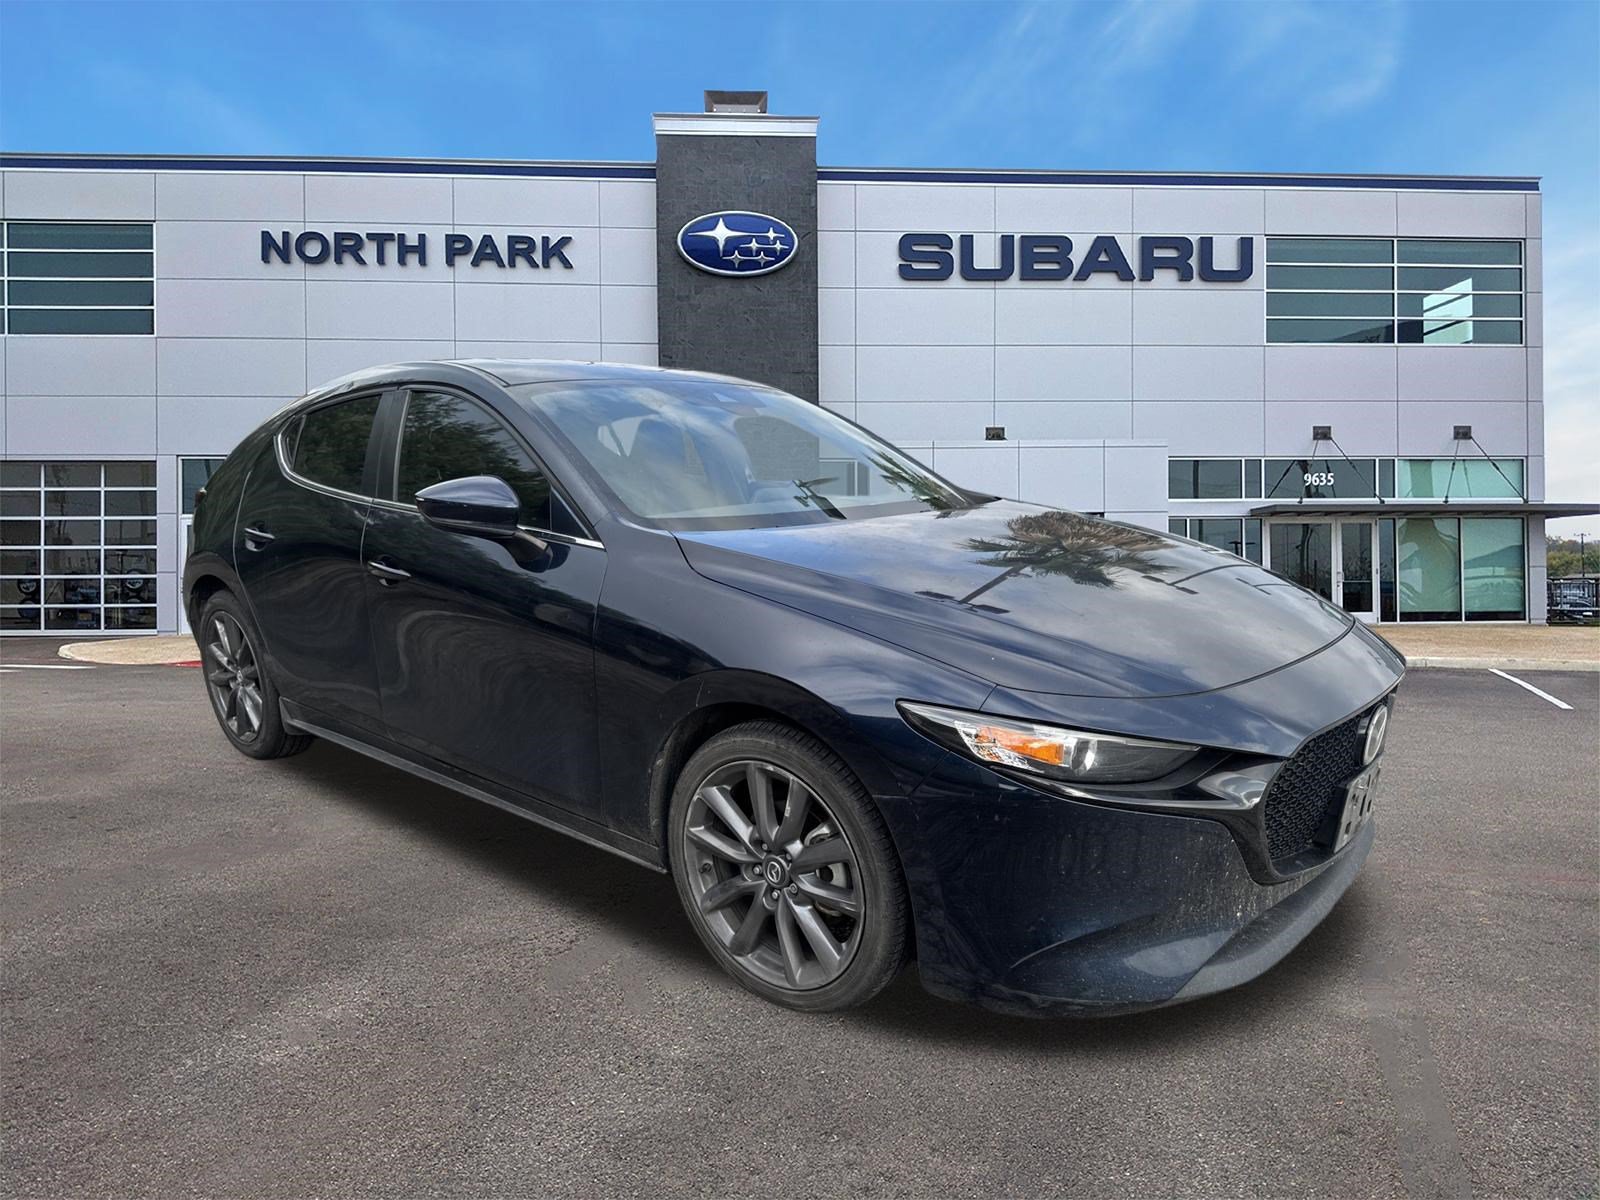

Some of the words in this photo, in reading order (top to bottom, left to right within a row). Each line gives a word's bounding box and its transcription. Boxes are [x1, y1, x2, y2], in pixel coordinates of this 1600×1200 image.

[260, 230, 427, 267] NORTH
[445, 233, 573, 269] PARK
[898, 232, 1254, 282] SUBARU
[1303, 472, 1334, 486] 9635
